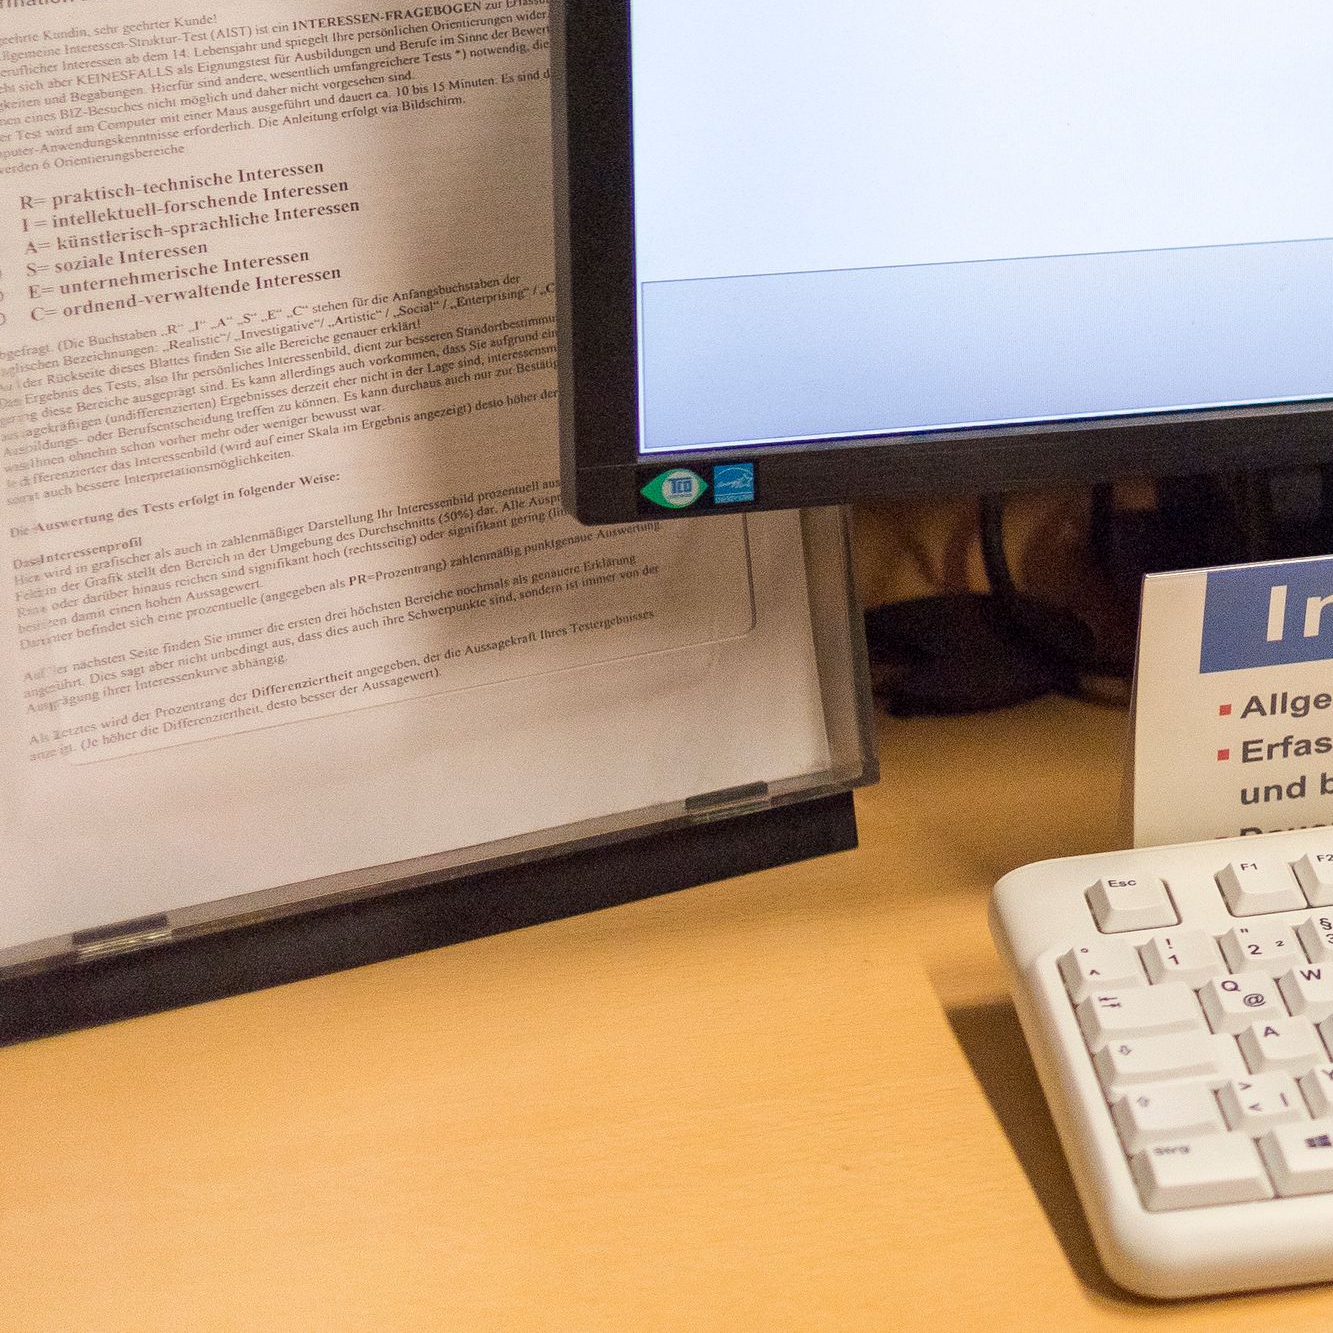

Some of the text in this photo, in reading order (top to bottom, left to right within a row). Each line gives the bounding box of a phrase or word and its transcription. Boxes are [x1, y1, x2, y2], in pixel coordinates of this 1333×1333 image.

[210, 1, 482, 42] (AIST) INTERESSEN-FRAGEBOGEN
[294, 44, 373, 63] Ausbildungen
[375, 41, 396, 54] und
[396, 85, 409, 97] 10
[412, 83, 429, 96] bis
[432, 80, 445, 93] 15
[258, 118, 279, 129] Die
[282, 111, 339, 127] Anleitung
[52, 172, 233, 210] praktisch-technische
[238, 161, 324, 184] Interessen
[53, 191, 258, 229] intellektuell-forschende
[263, 180, 349, 202] Interessen
[56, 212, 270, 251] künstlerisch-sprachliche
[274, 201, 360, 222] Interessen
[54, 254, 114, 273] soziale
[119, 242, 208, 264] Interessen
[60, 262, 219, 296] unternehmerische
[223, 251, 310, 272] Interessen
[63, 280, 251, 317] ordnend-verwaltende
[256, 268, 341, 291] Interessen
[312, 299, 349, 314] stehen
[371, 294, 389, 305] die
[392, 278, 500, 302] Anfangsbuchstaben
[117, 506, 138, 518] des
[142, 500, 175, 514] Tests
[178, 492, 220, 509] erfolgt
[222, 489, 235, 501] in
[238, 479, 296, 498] folgender
[299, 472, 341, 486] Weise:
[251, 670, 353, 700] Differenziertheit
[1240, 772, 1307, 806] und
[1239, 862, 1258, 871] F1
[1316, 854, 1333, 863] F2
[1107, 879, 1137, 888] Esc
[1247, 944, 1262, 956] 2
[1220, 980, 1240, 992] Q
[1300, 968, 1322, 981] W
[1263, 1026, 1280, 1038] A
